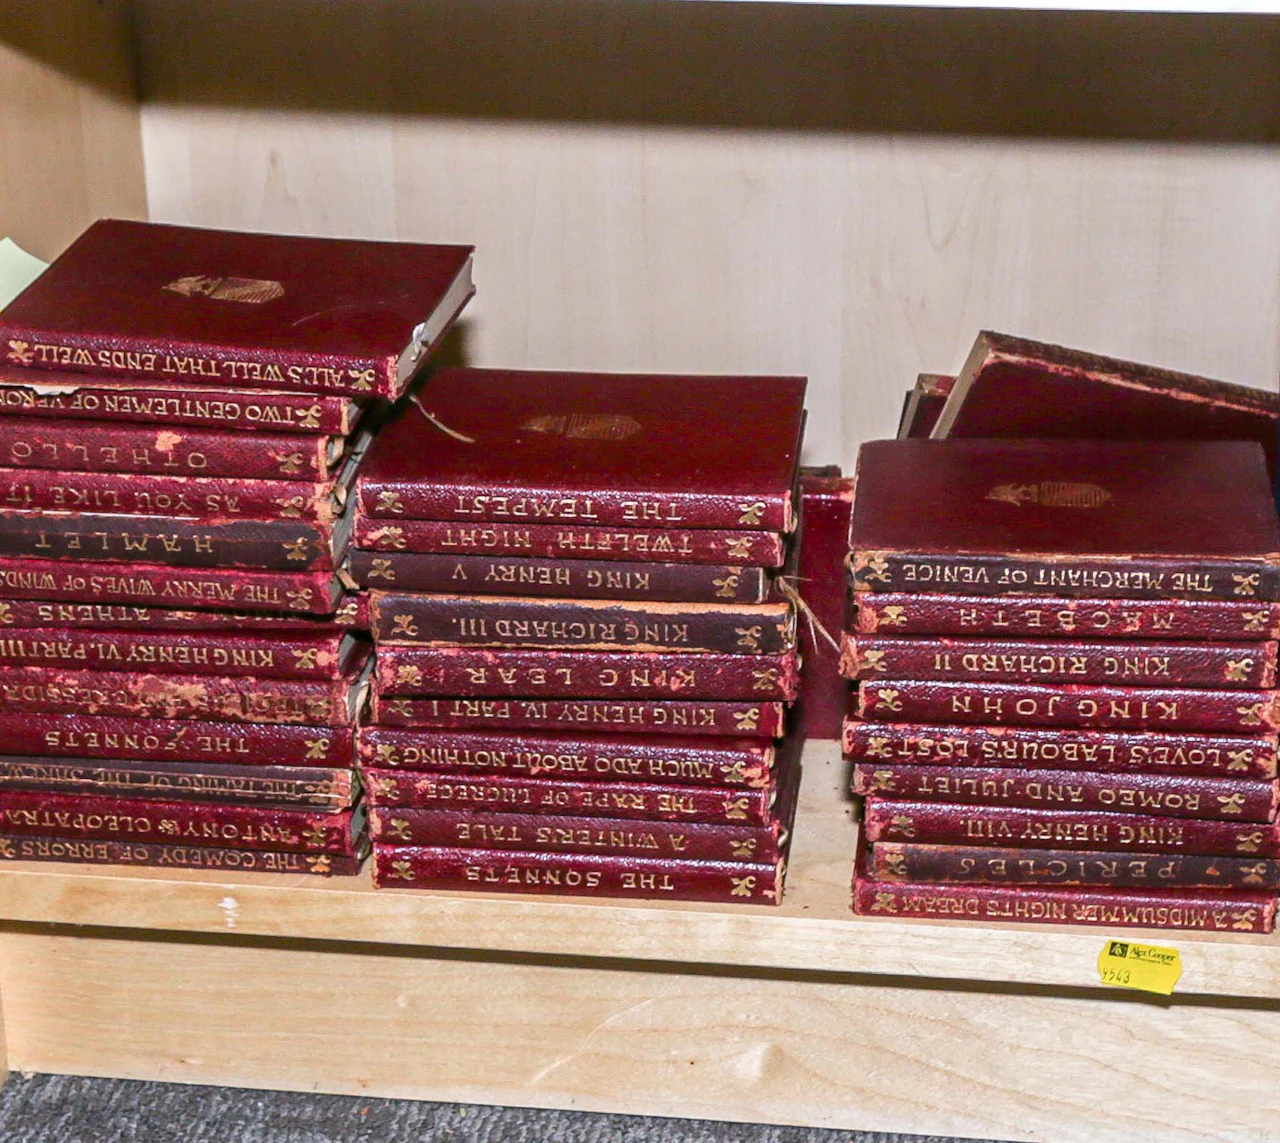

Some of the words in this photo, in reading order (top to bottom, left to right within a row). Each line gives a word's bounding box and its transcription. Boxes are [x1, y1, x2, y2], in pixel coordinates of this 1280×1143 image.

[34, 345, 95, 365] WELL
[99, 350, 155, 370] ENDS
[162, 356, 220, 376] THAT
[224, 360, 284, 381] WELL
[288, 365, 345, 386] ALL'S
[73, 394, 98, 409] OF
[104, 394, 240, 420] GENTLEMEN
[246, 406, 295, 423] TWO
[10, 441, 207, 468] OTHELLO
[6, 484, 31, 502] IT
[50, 487, 118, 506] LIKE
[134, 491, 192, 509] YOU
[207, 494, 239, 512] AS
[454, 495, 597, 519] TEMPEST
[621, 502, 681, 520] THE
[35, 531, 212, 552] HAMLET
[441, 528, 531, 548] NIGHT
[558, 532, 692, 553] TWELFTH
[452, 563, 467, 580] V
[484, 563, 570, 586] HENRY
[586, 569, 649, 590] KING
[902, 564, 990, 583] VENICE
[997, 568, 1027, 584] OF
[1033, 567, 1163, 590] MERCHANT
[64, 576, 86, 589] OF
[91, 576, 153, 595] WIVES
[162, 580, 236, 600] MERRY
[1172, 573, 1213, 592] THE
[240, 586, 280, 603] THE
[39, 605, 148, 621] ATHENS
[959, 608, 1174, 630] MACBETH
[495, 618, 615, 639] RICHARD
[625, 622, 688, 641] KING
[31, 641, 85, 658] PART
[128, 646, 207, 665] HENRY
[213, 648, 273, 667] KING
[934, 653, 951, 670] II
[962, 653, 1087, 673] RICHARD
[1103, 656, 1170, 675] KING
[465, 667, 571, 685] LEAR
[600, 668, 695, 686] KING
[433, 700, 438, 716] I
[451, 700, 510, 718] PART
[559, 704, 644, 723] HENRY
[951, 695, 1060, 716] JOHN
[1077, 699, 1178, 720] KING
[653, 707, 715, 725] KING
[197, 735, 249, 753] THE
[898, 739, 968, 757] LOST
[981, 739, 1115, 762] LABOUR'S
[404, 747, 507, 766] NOTHING
[516, 752, 587, 772] ABOUT
[1129, 746, 1220, 766] LOVE'S
[594, 757, 642, 775] ADO
[651, 761, 713, 778] MUCH
[541, 789, 569, 805] OF
[918, 775, 1014, 800] JULIET
[1026, 782, 1082, 801] AND
[582, 791, 645, 809] RAPE
[659, 794, 696, 813] THE
[1098, 789, 1200, 809] ROMEO
[4, 810, 151, 834] CLEOPATRA
[159, 819, 178, 836] &
[184, 819, 293, 842] ANTONY
[456, 823, 521, 841] TALE
[537, 827, 657, 848] WINTER'S
[1020, 821, 1107, 843] HENRY
[1119, 824, 1183, 844] KING
[21, 841, 107, 859] ERRORS
[669, 835, 685, 850] A
[121, 845, 148, 860] OF
[159, 847, 255, 867] COMEDY
[263, 851, 300, 869] THE
[465, 866, 601, 887] SONNETS
[958, 857, 1175, 877] PERICLES
[622, 872, 674, 890] THE
[902, 895, 979, 915] DREAM
[986, 899, 1066, 919] NIGHT'S
[1072, 901, 1207, 927] MIDSUMMER
[1208, 909, 1227, 927] A
